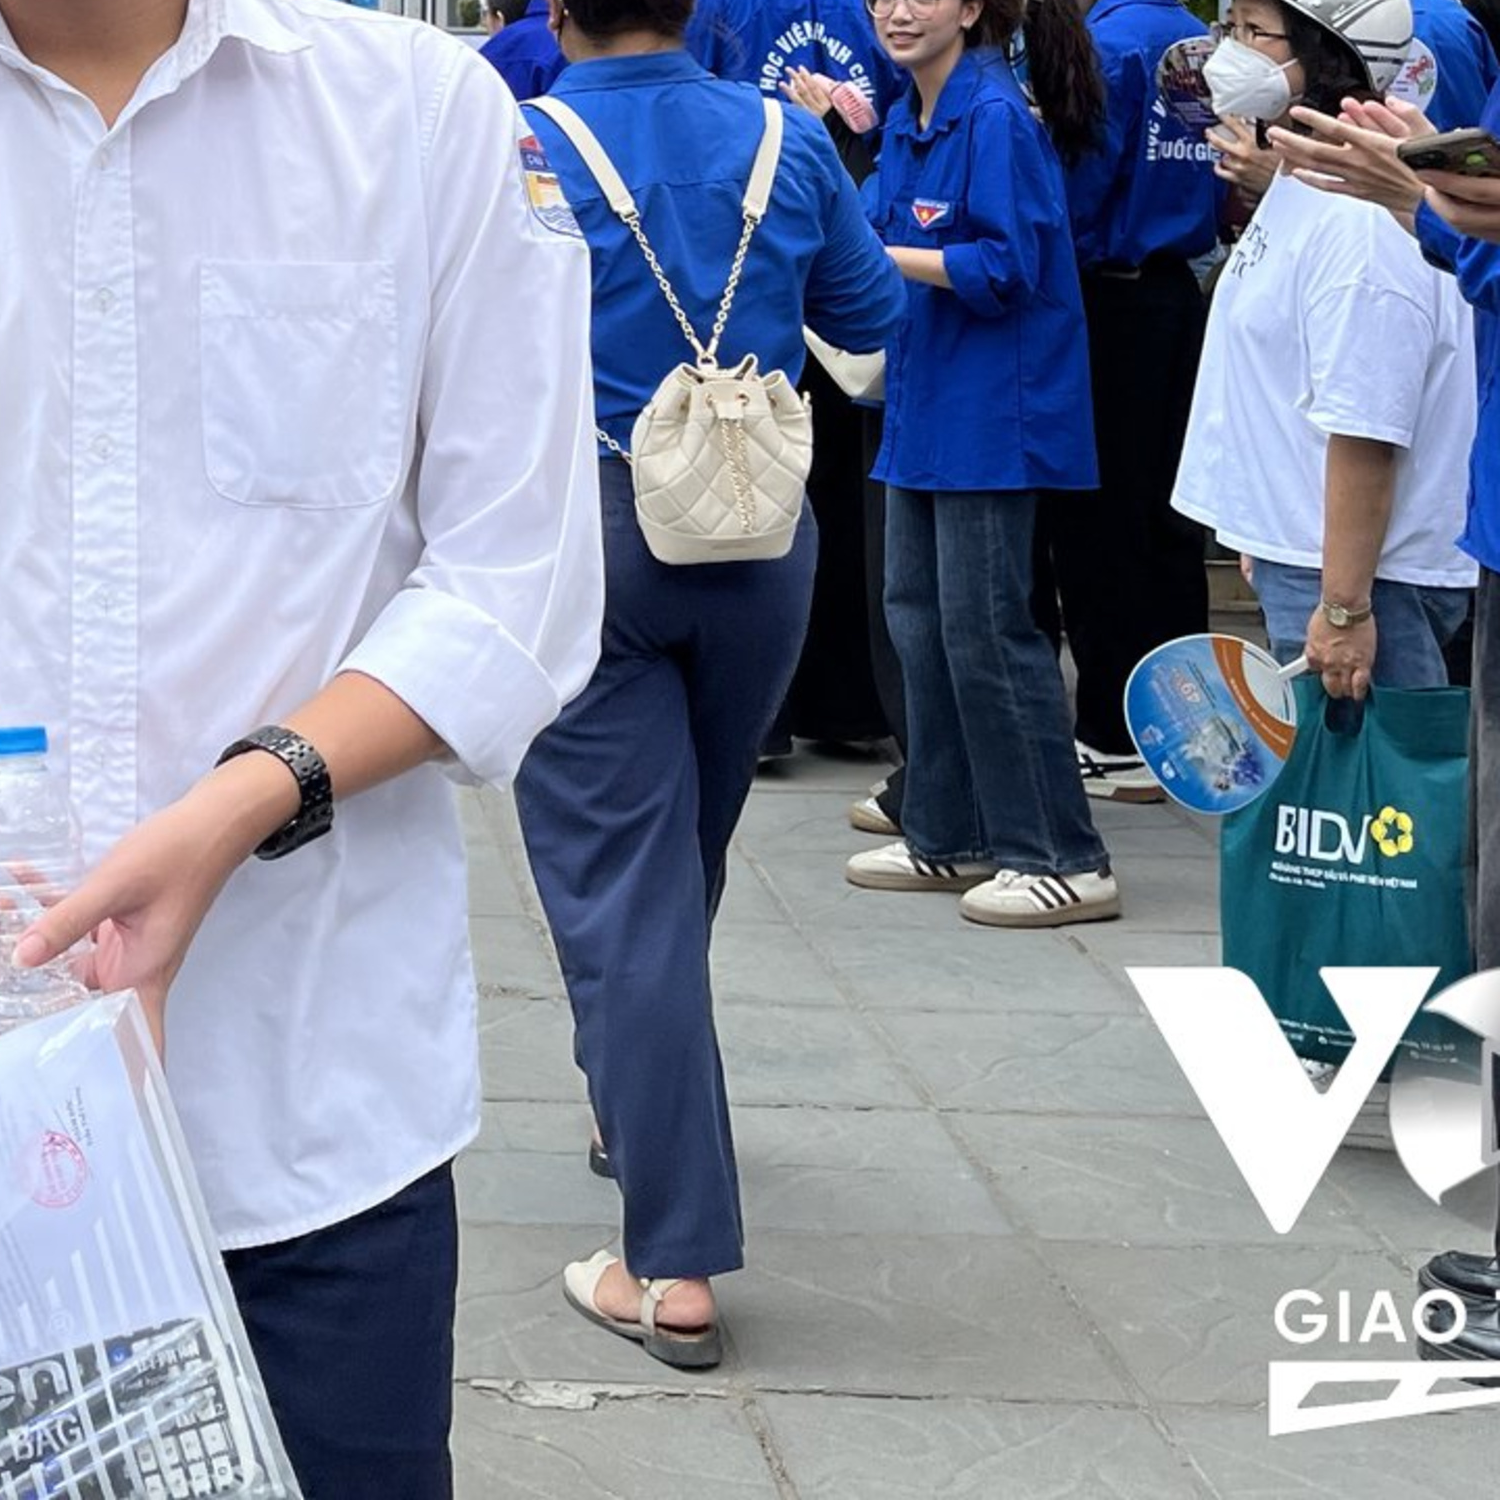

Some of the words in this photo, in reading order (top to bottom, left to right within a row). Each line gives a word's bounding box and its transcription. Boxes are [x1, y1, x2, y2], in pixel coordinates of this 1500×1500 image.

[759, 51, 784, 91] HỌC
[1275, 804, 1373, 865] BIDV
[7, 1412, 85, 1462] BAG
